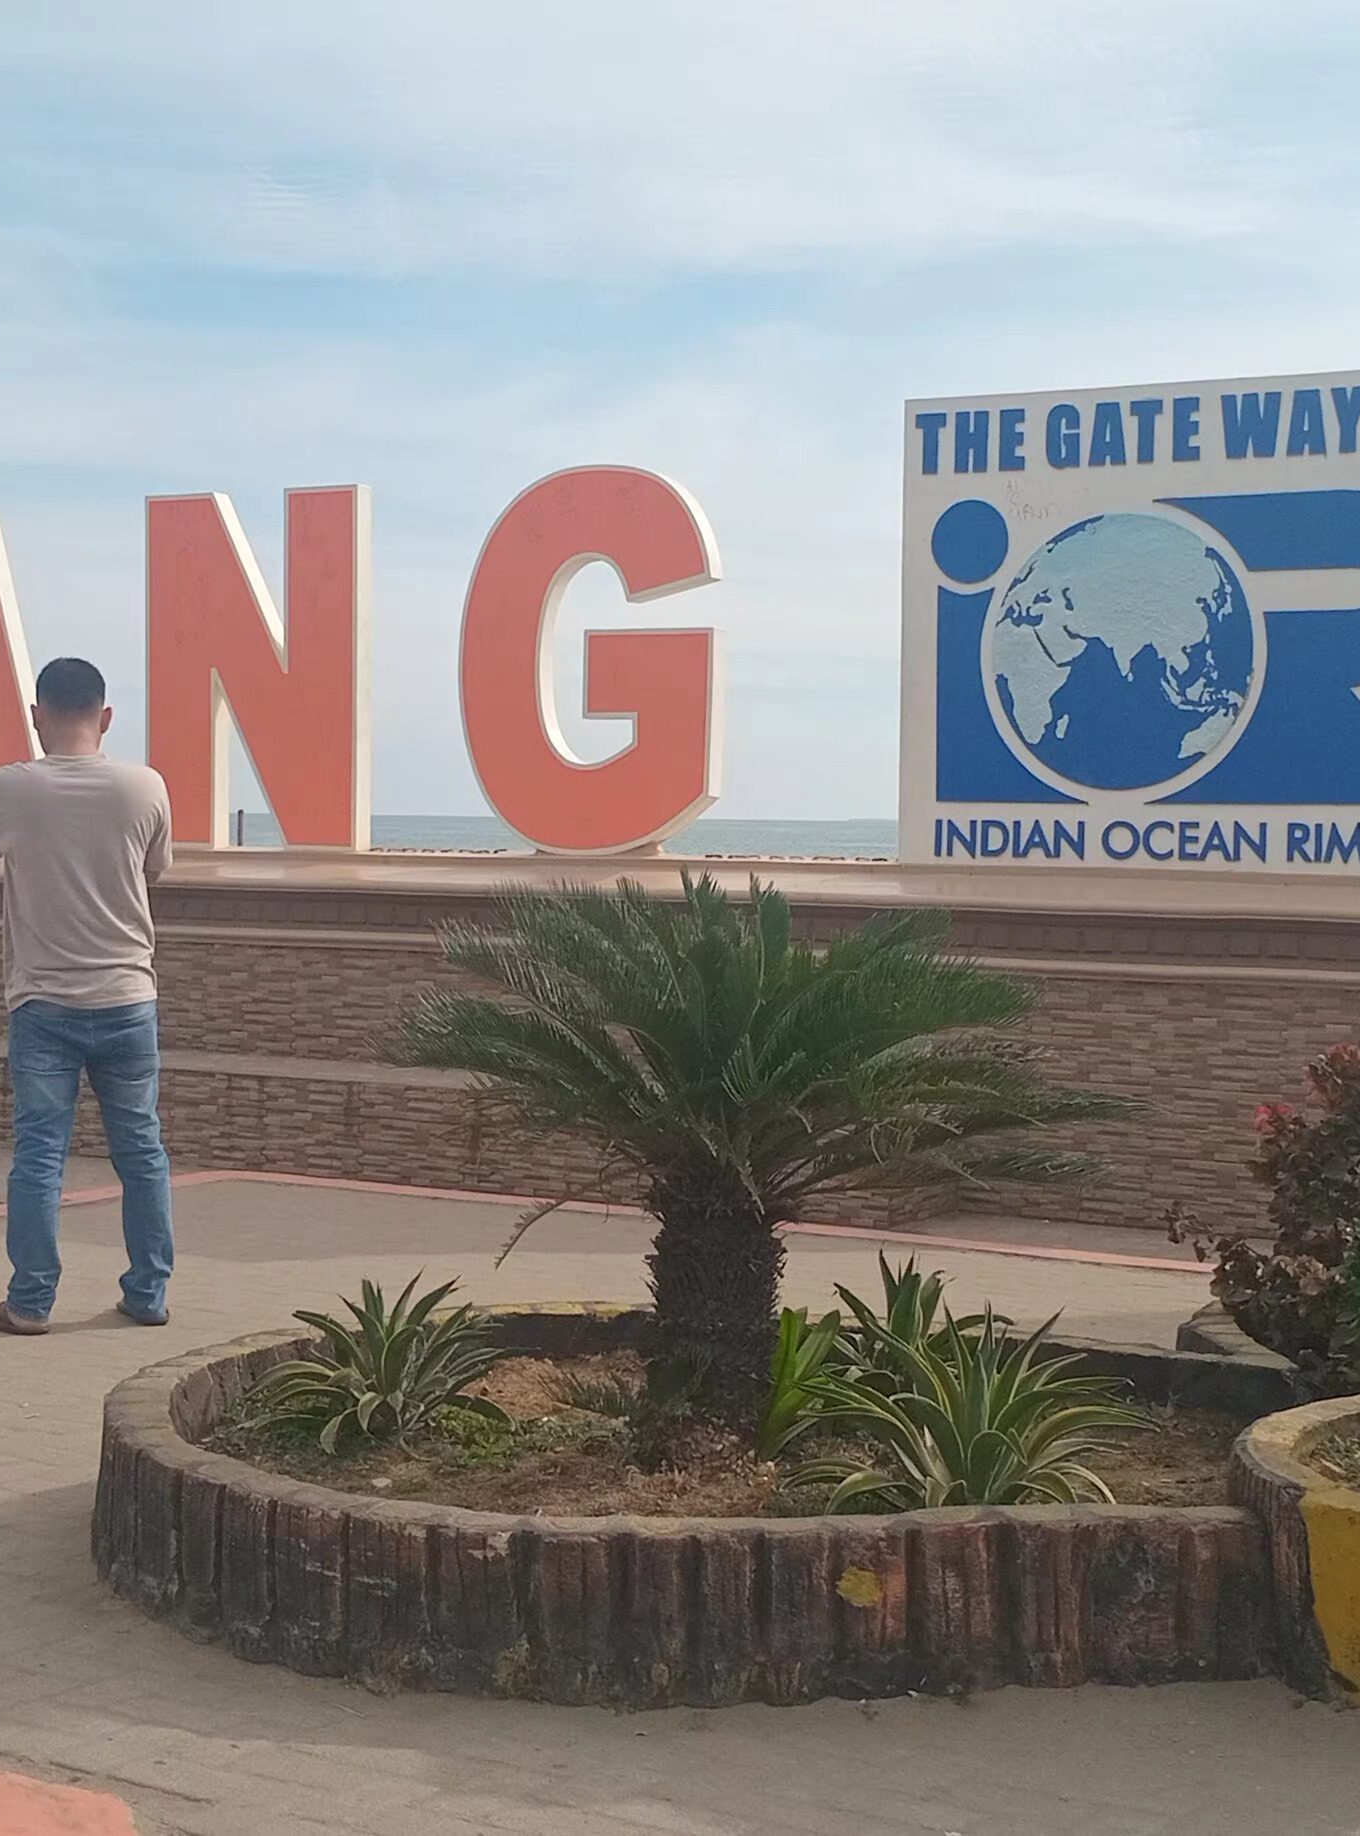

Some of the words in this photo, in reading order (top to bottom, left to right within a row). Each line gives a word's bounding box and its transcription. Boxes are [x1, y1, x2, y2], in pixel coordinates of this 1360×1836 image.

[915, 408, 1026, 475] THE
[1045, 395, 1201, 470] GATE
[934, 818, 1086, 860] INDIAN
[1101, 819, 1267, 863] OCEAN
